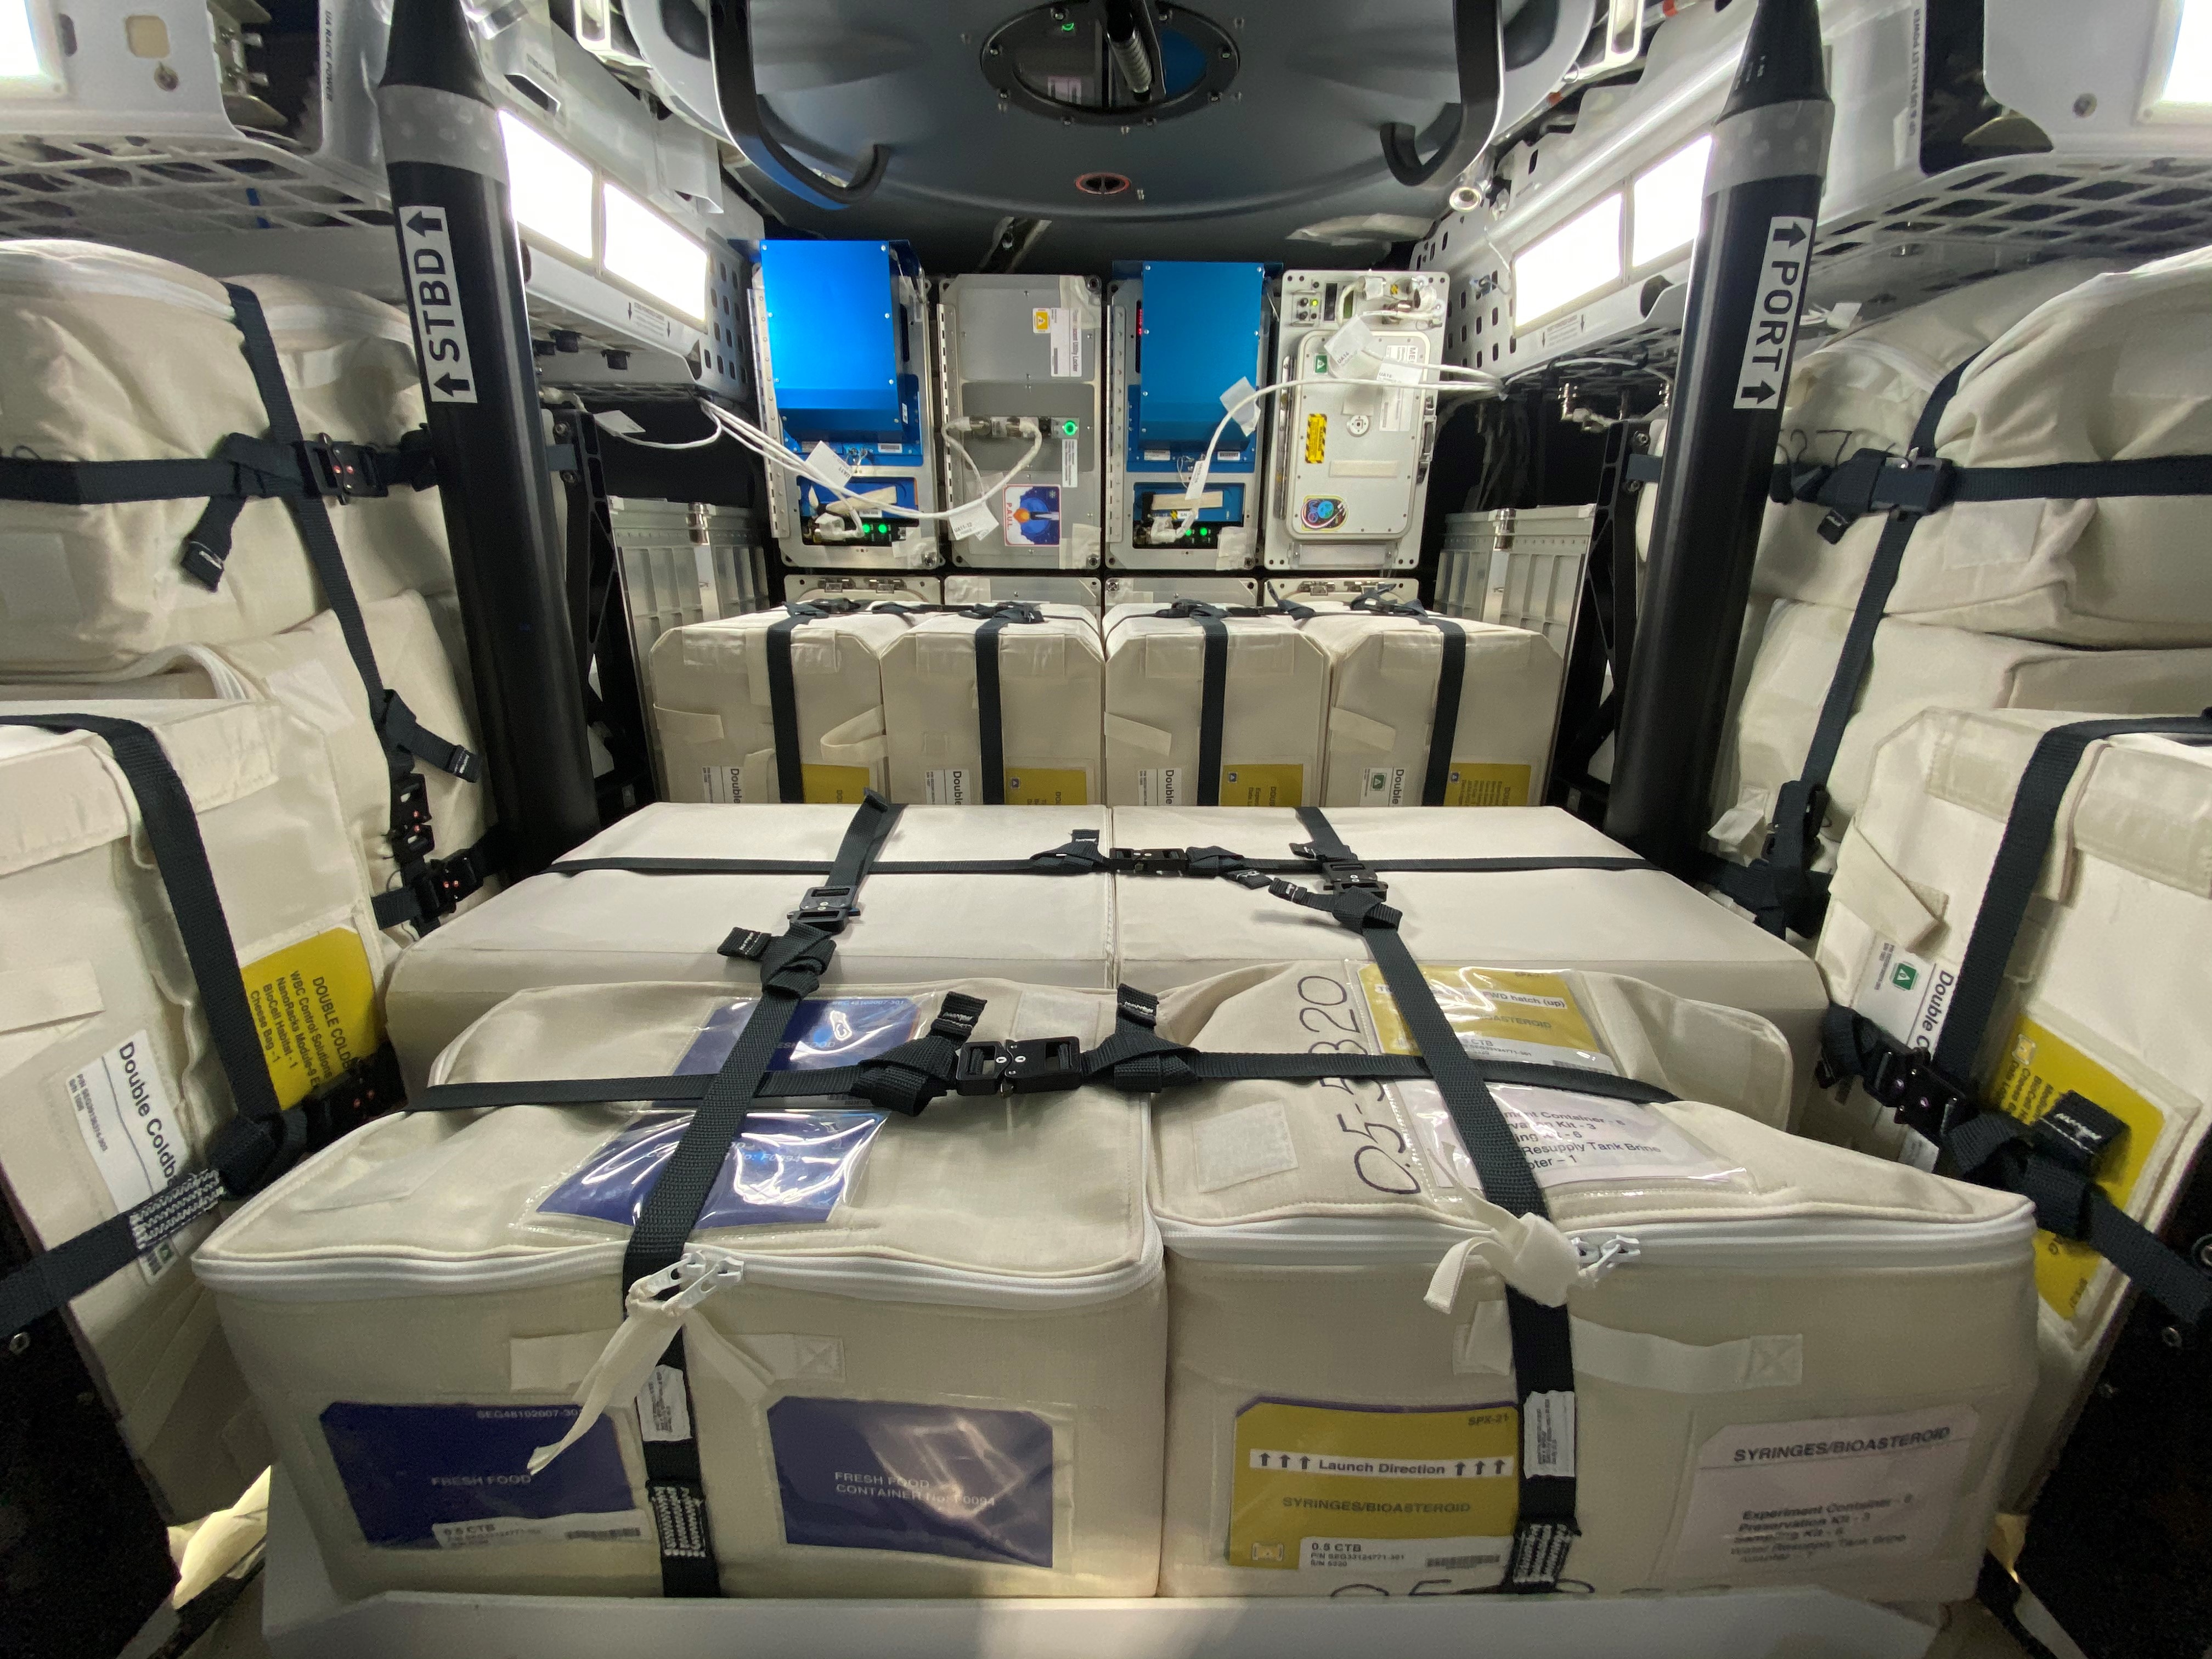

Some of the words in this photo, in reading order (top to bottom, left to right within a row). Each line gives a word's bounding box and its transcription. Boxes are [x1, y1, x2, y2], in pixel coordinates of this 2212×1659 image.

[413, 247, 461, 363] STBD
[1754, 261, 1801, 373] PORT
[730, 768, 741, 804] Double
[952, 770, 962, 805] Double
[1165, 769, 1175, 805] Double
[1392, 769, 1404, 805] Double
[275, 976, 301, 1032] NanoRacks
[290, 969, 306, 996] WBC
[298, 996, 319, 1034] Control
[312, 976, 340, 1028] DOUBLE
[1509, 994, 1541, 1005] hatch
[1543, 997, 1566, 1008] (up)
[1922, 969, 1955, 1032] Double
[250, 990, 268, 1029] Cheese
[263, 1028, 274, 1051] Bag
[263, 983, 282, 1020] BioCell
[275, 1020, 293, 1056] Habitat
[119, 1041, 150, 1117] Double
[1540, 1111, 1605, 1124] Container
[1555, 1120, 1577, 1129] Kit
[1522, 1142, 1585, 1156] Resupply
[1586, 1142, 1623, 1151] Tank
[1623, 1143, 1662, 1153] Brine
[1468, 1412, 1510, 1427] SPX-21
[1733, 1426, 1951, 1463] SYRINGES/BIOASTEROID
[431, 1476, 483, 1486] FRESH
[487, 1474, 532, 1485] FOOD
[834, 1471, 884, 1486] FRESH
[888, 1476, 930, 1488] FOOD
[1318, 1459, 1374, 1473] Launch
[1378, 1463, 1446, 1475] Direction
[836, 1483, 924, 1501] CONTAINER
[1282, 1496, 1472, 1514] SYRINGES/BIOASTEROID
[1742, 1504, 1824, 1521] Experiment
[1825, 1498, 1892, 1514] Container
[1737, 1517, 1828, 1532] Preservation
[1830, 1514, 1851, 1525] Kit
[1334, 1543, 1363, 1553] CTB
